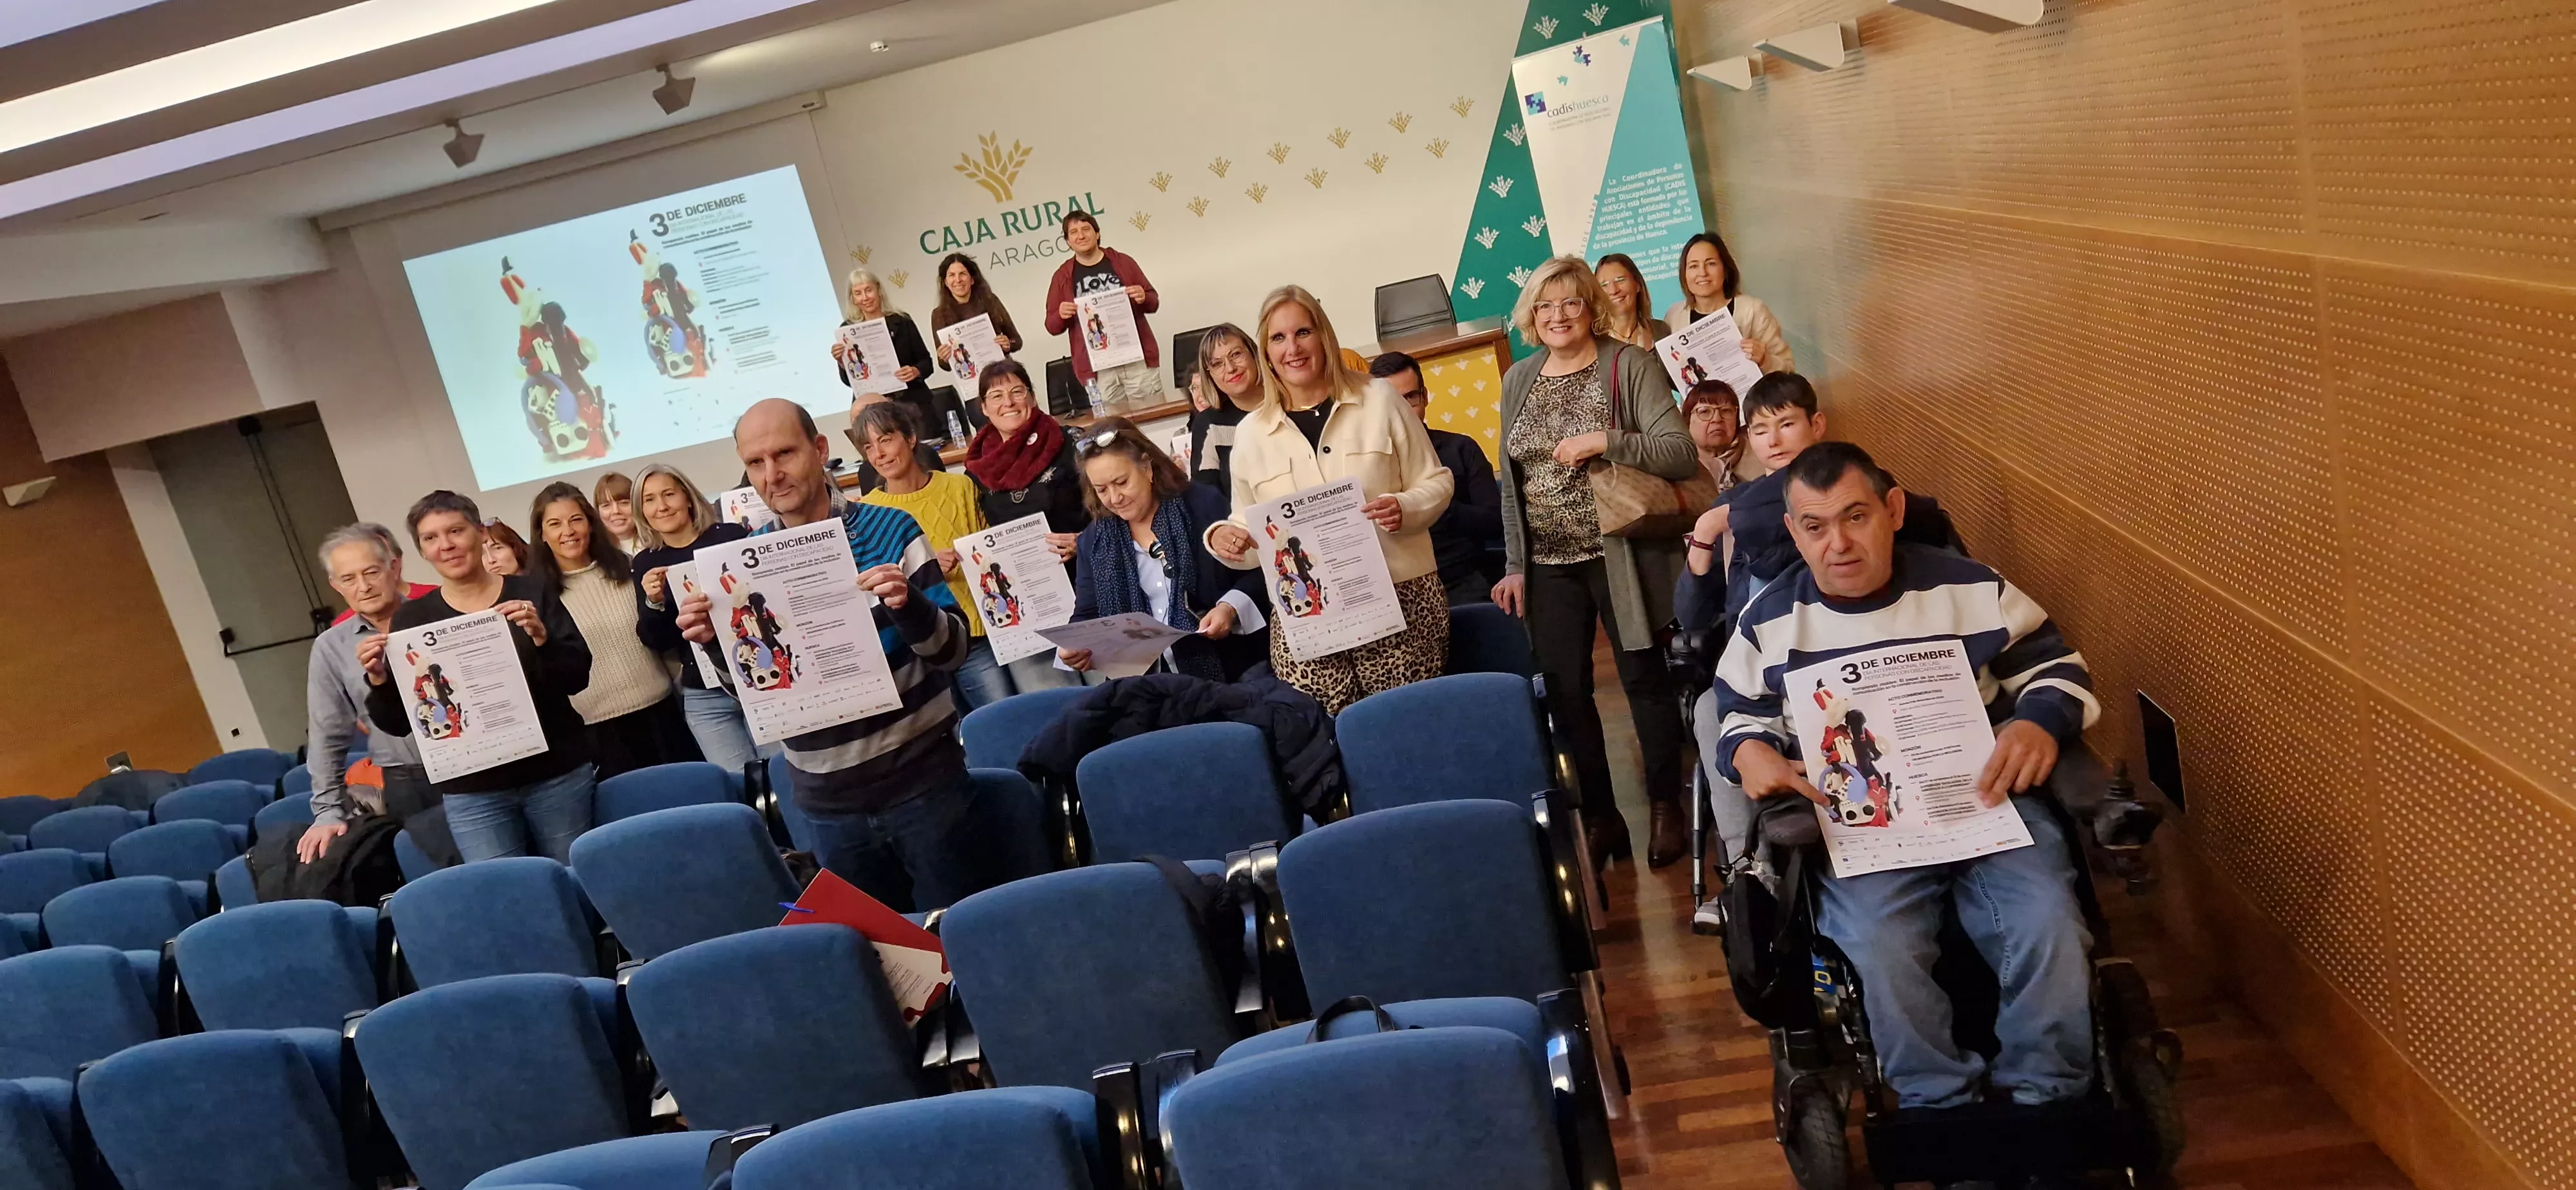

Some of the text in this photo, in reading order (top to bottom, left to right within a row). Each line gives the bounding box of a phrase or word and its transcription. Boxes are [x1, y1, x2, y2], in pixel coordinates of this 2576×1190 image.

[1548, 95, 1609, 118] cadishuesca
[1607, 182, 1645, 194] Asociaciones
[1656, 173, 1684, 183] Personas
[1622, 167, 1667, 182] Coordinadora
[1619, 185, 1661, 200] Discapacidad
[1665, 180, 1686, 191] (CADIS
[649, 212, 669, 237] 3
[666, 209, 683, 221] DE
[685, 193, 747, 216] DICIEMBRE
[1599, 198, 1689, 223] principales entidades que
[1601, 202, 1626, 213] HUESCA)
[1641, 194, 1666, 204] formada
[920, 191, 1105, 255] CAJA RURAL
[1595, 226, 1633, 241] discapacidad
[1654, 215, 1692, 228] dependencia
[1597, 221, 1624, 232] trabajan
[990, 231, 1073, 270] ARAGÓ
[1608, 236, 1636, 248] provincia
[1678, 334, 1689, 346] 3
[1695, 313, 1726, 332] DICIEMBRE
[741, 493, 748, 503] 3
[1280, 502, 1296, 519] 3
[1293, 498, 1305, 507] DE
[1307, 483, 1354, 503] DICIEMBRE
[984, 534, 996, 548] 3
[1005, 519, 1042, 534] DICIEMBRE
[741, 529, 837, 569] 3 DE DICIEMBRE
[422, 631, 437, 647] 3
[435, 627, 448, 636] DE
[450, 615, 498, 632] DICIEMBRE
[1841, 648, 1956, 685] 3 DE DICIEMBRE
[1864, 672, 1895, 681] PERSONAS
[1910, 665, 1953, 674] DISCAPACIDAD
[1873, 663, 1917, 674] INTERNACIONAL
